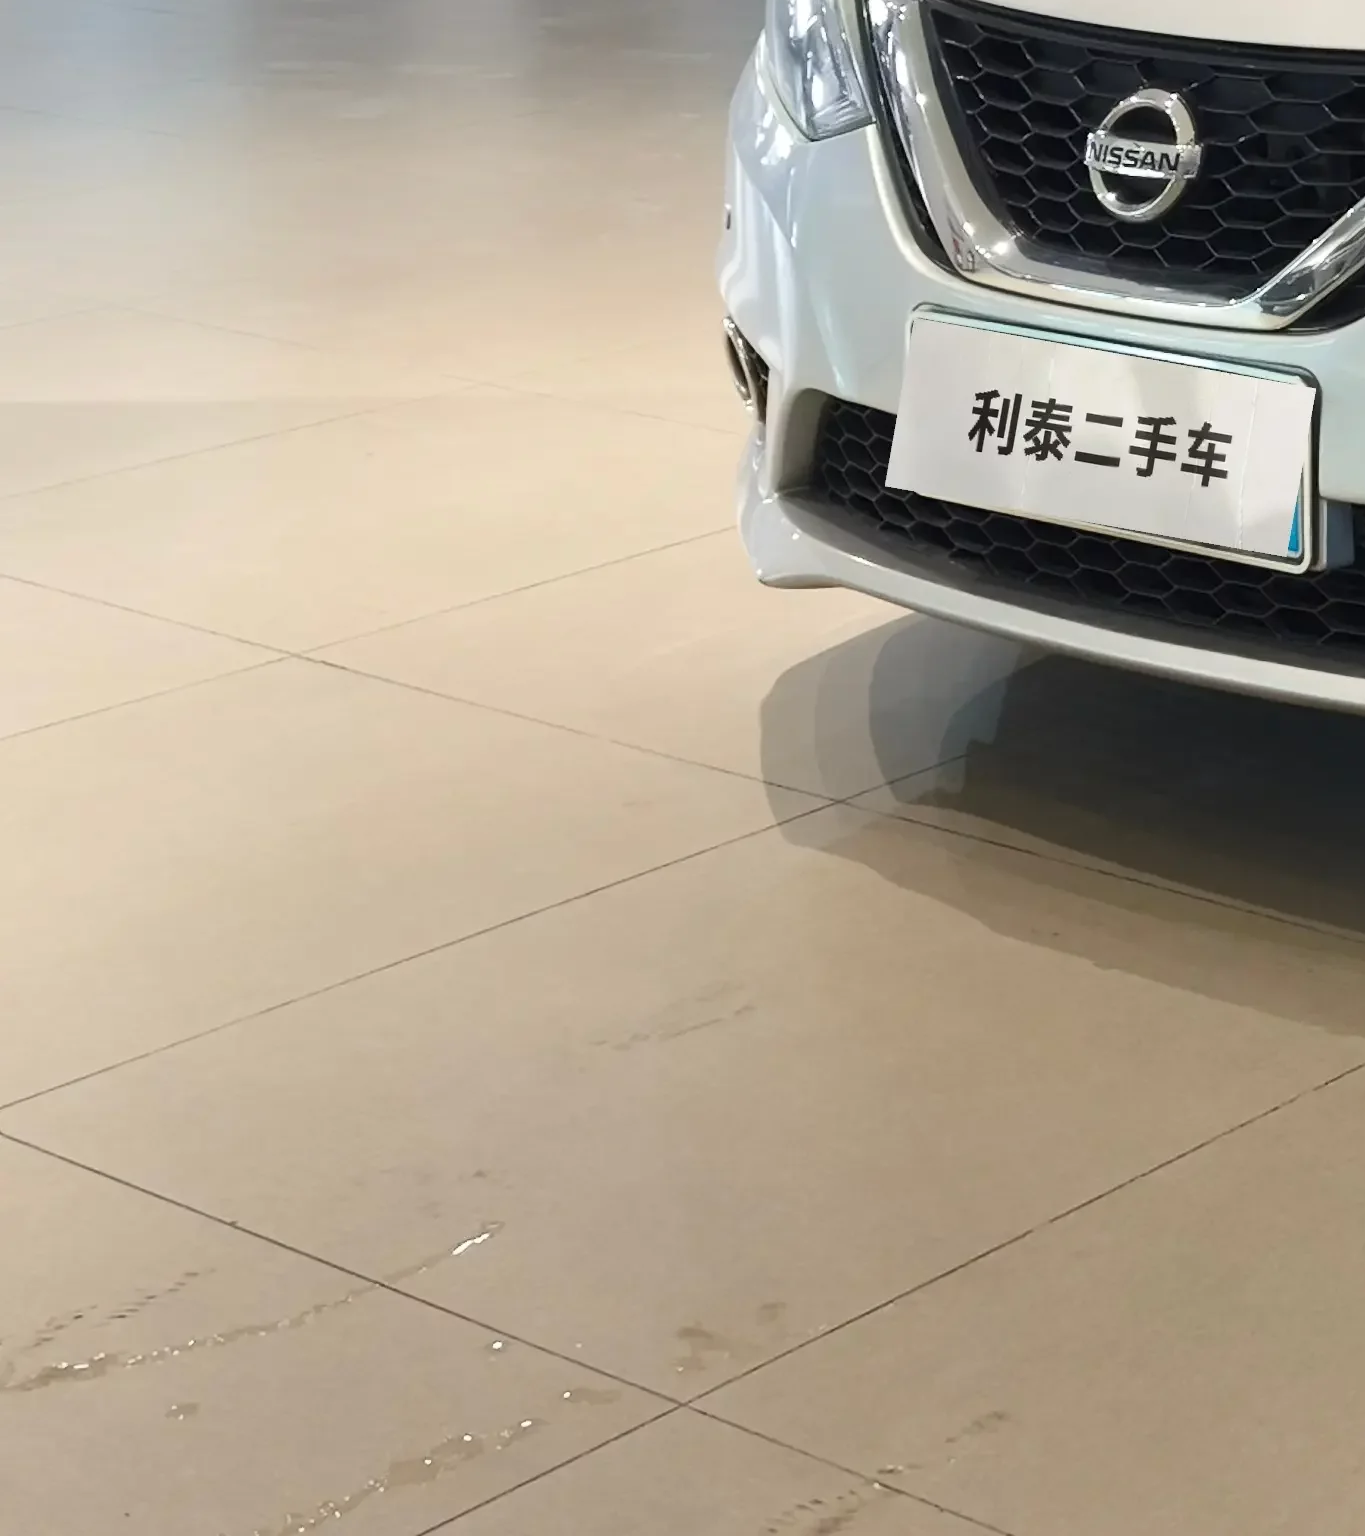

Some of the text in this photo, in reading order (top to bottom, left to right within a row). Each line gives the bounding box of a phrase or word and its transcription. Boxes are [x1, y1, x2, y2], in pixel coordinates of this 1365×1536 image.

[1087, 140, 1181, 172] NISSAN
[967, 389, 1233, 487] 利泰二手车
